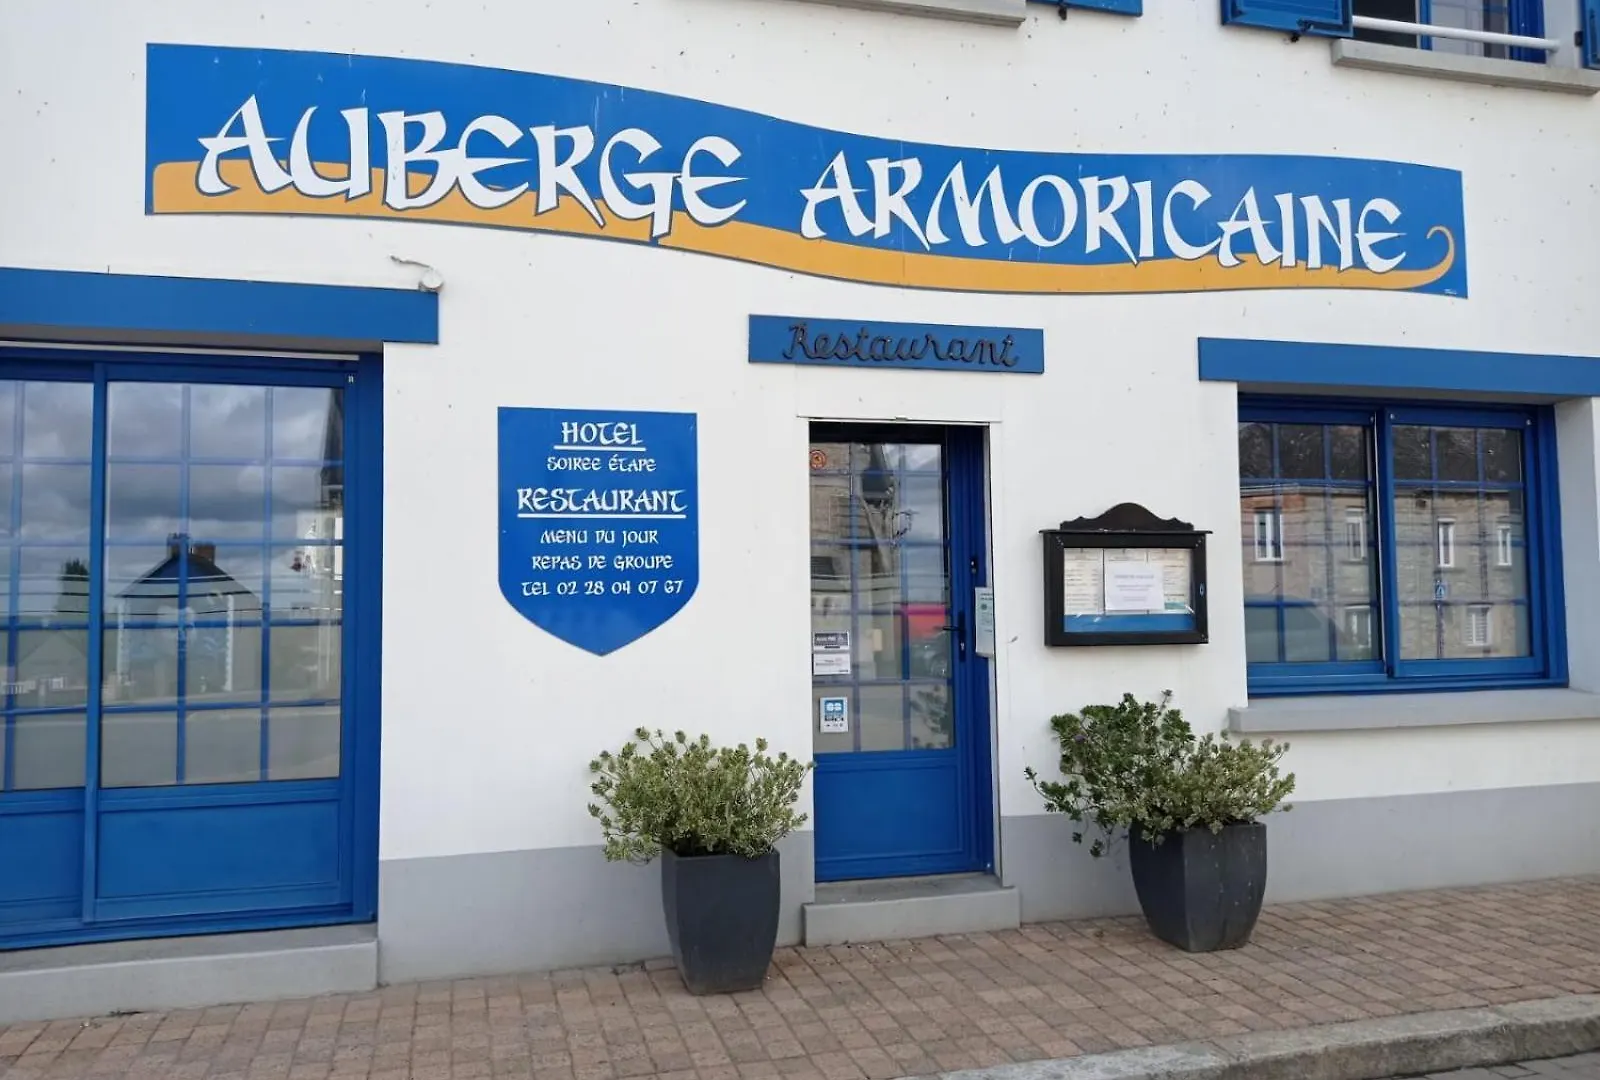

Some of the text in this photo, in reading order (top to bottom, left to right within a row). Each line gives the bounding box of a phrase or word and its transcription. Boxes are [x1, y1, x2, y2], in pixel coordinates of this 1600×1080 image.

[197, 94, 1408, 273] AUBERGE ARMORICAINE
[782, 322, 1020, 368] Restaurant
[561, 421, 643, 445] HOTEL
[547, 453, 657, 472] SOIREE ÉTAPE
[517, 487, 688, 513] RESTAURANT
[540, 529, 658, 548] MENU DU JOUR
[532, 555, 673, 571] REPAS DE GROUPE
[521, 580, 684, 596] TEL 02 28 04 07 67
